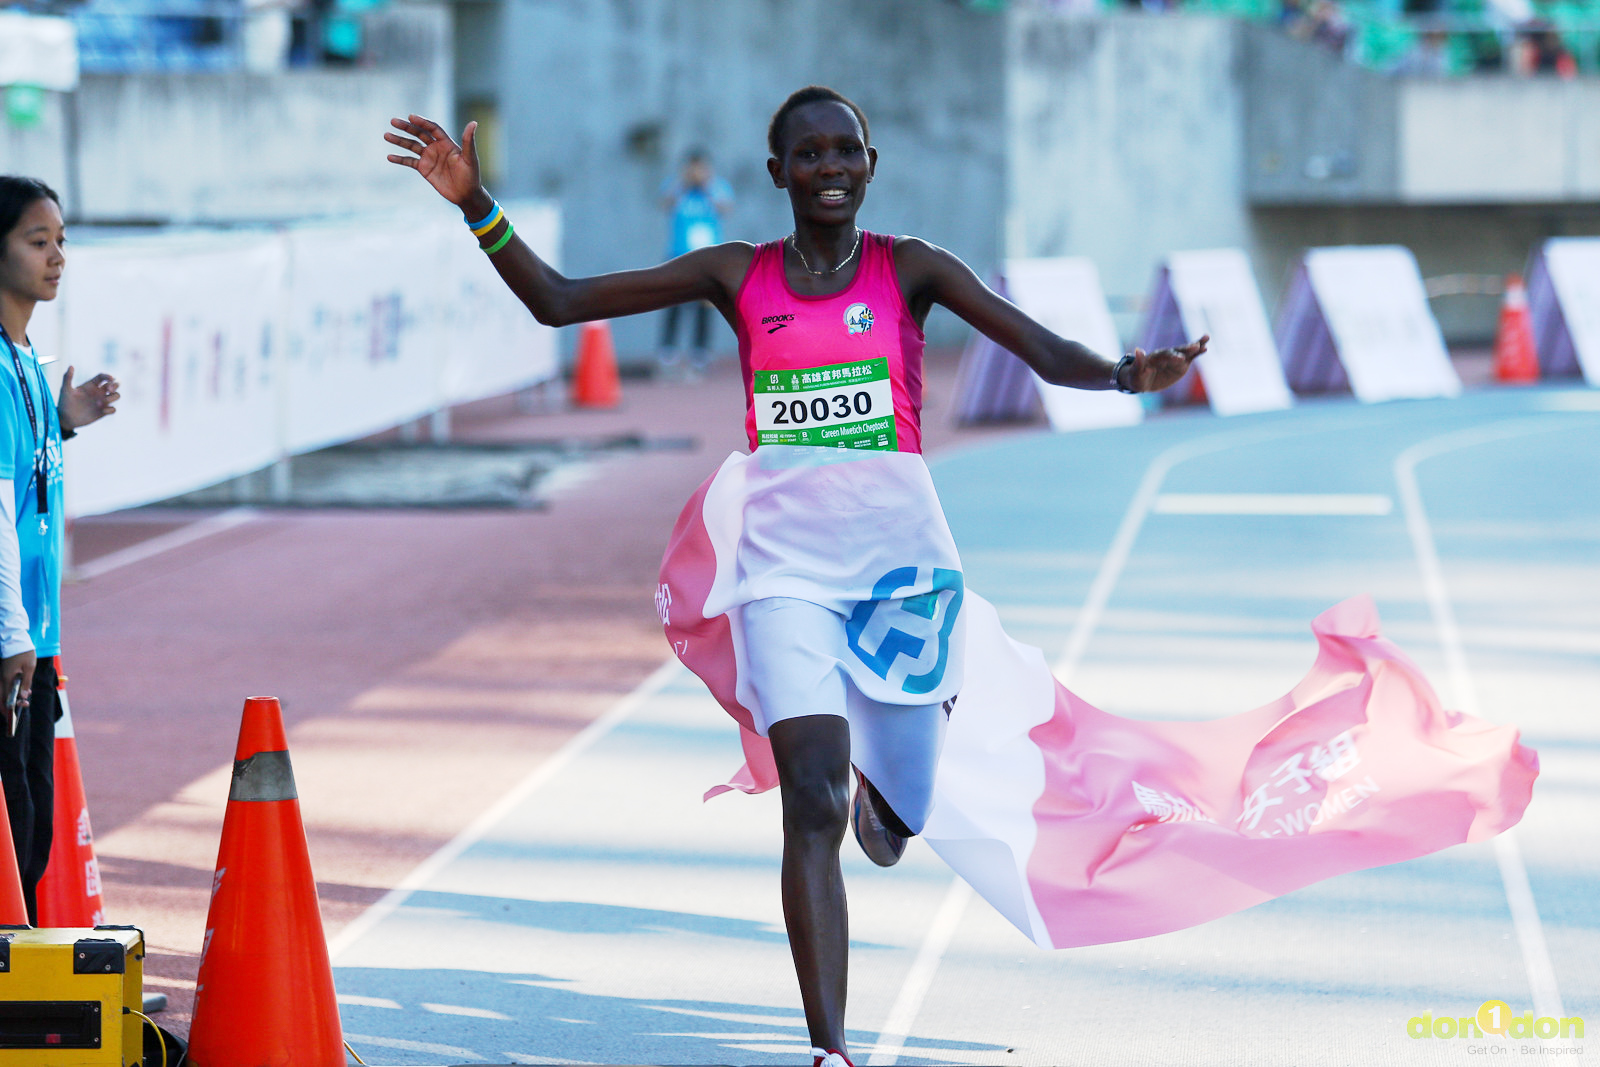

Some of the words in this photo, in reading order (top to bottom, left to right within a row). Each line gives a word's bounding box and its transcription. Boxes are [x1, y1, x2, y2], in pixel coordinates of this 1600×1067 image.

[762, 314, 795, 324] BROOKS
[801, 364, 873, 384] 高雄富邦馬拉松
[771, 391, 872, 424] 20030
[821, 427, 840, 439] Careen
[839, 423, 862, 436] Mwetich
